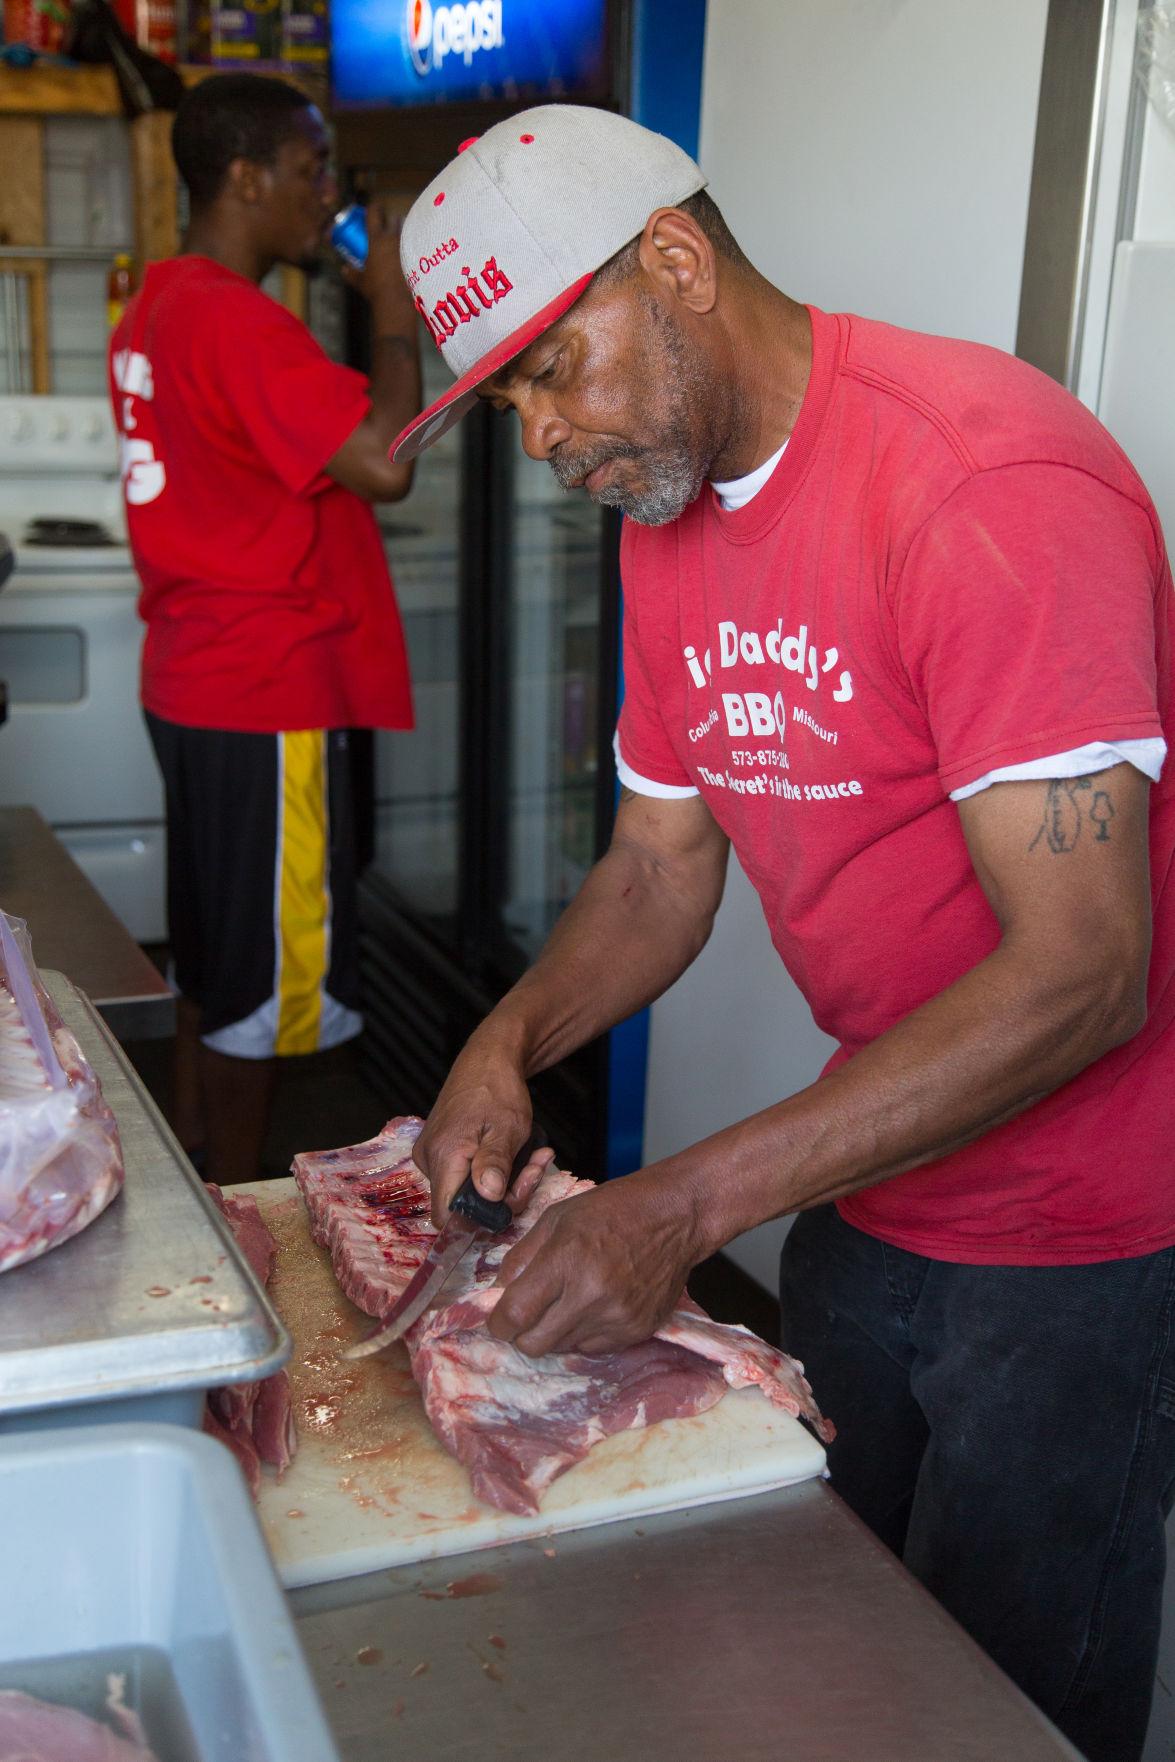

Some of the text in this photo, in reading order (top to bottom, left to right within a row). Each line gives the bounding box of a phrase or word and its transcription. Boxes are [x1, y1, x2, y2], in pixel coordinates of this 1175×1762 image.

[433, 0, 505, 70] pepsi
[420, 238, 460, 274] Outta
[415, 256, 513, 353] Louis
[718, 618, 853, 702] Daddy's
[721, 691, 785, 743] BBQ
[792, 706, 838, 745] Missouri
[697, 767, 726, 787] The
[782, 778, 802, 800] the
[804, 780, 863, 801] sauce
